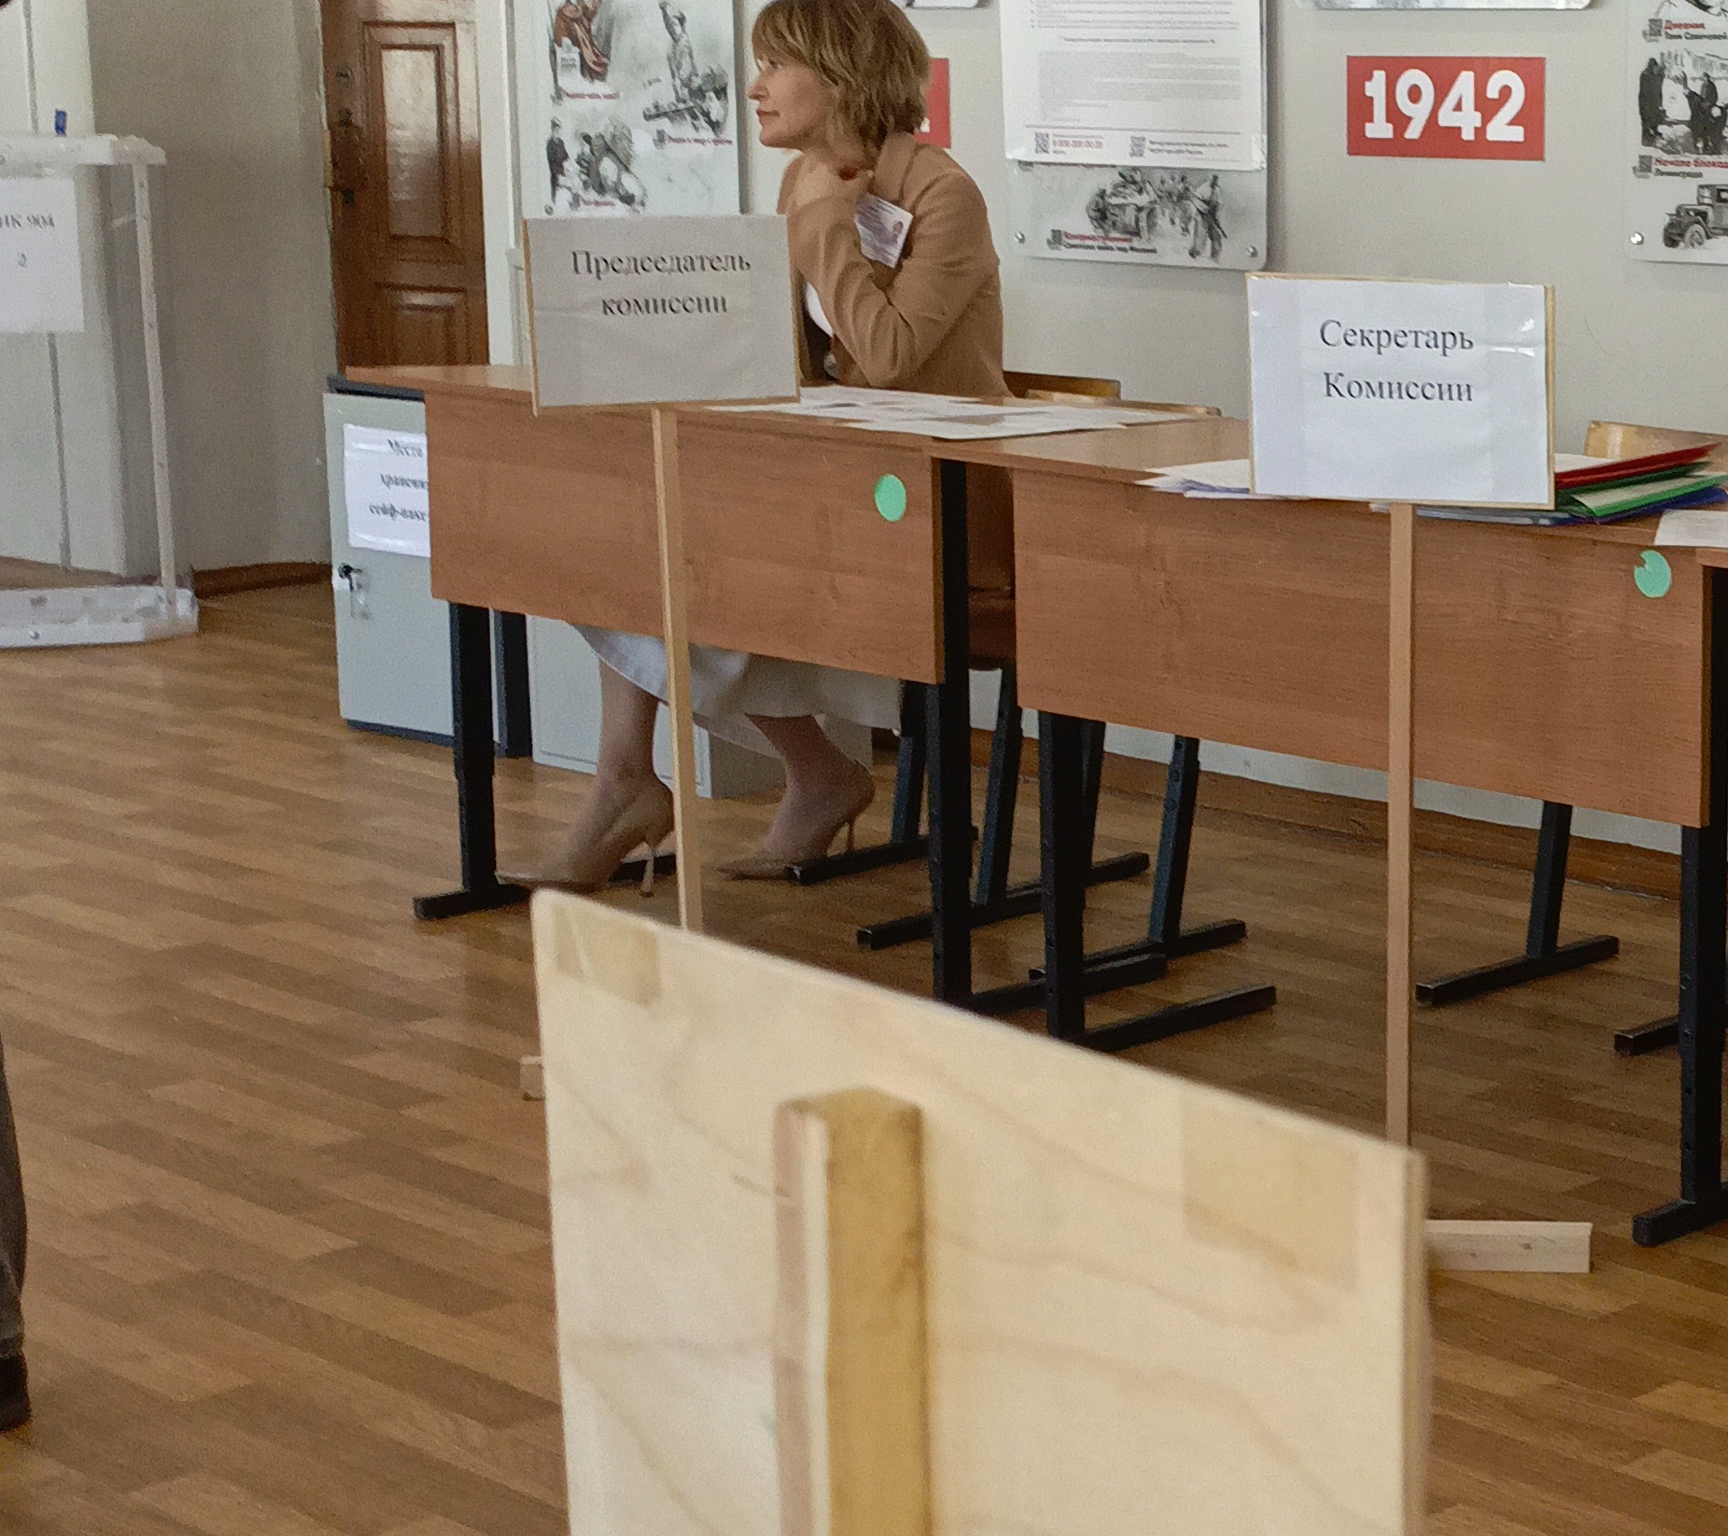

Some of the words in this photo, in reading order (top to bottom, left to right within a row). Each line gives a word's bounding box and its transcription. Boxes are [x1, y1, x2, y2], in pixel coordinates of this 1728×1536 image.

[1364, 69, 1526, 142] 1942
[571, 249, 751, 281] Председатель
[601, 295, 728, 316] комиссии
[1319, 319, 1474, 357] Секретарь
[1323, 371, 1473, 402] Комиссии
